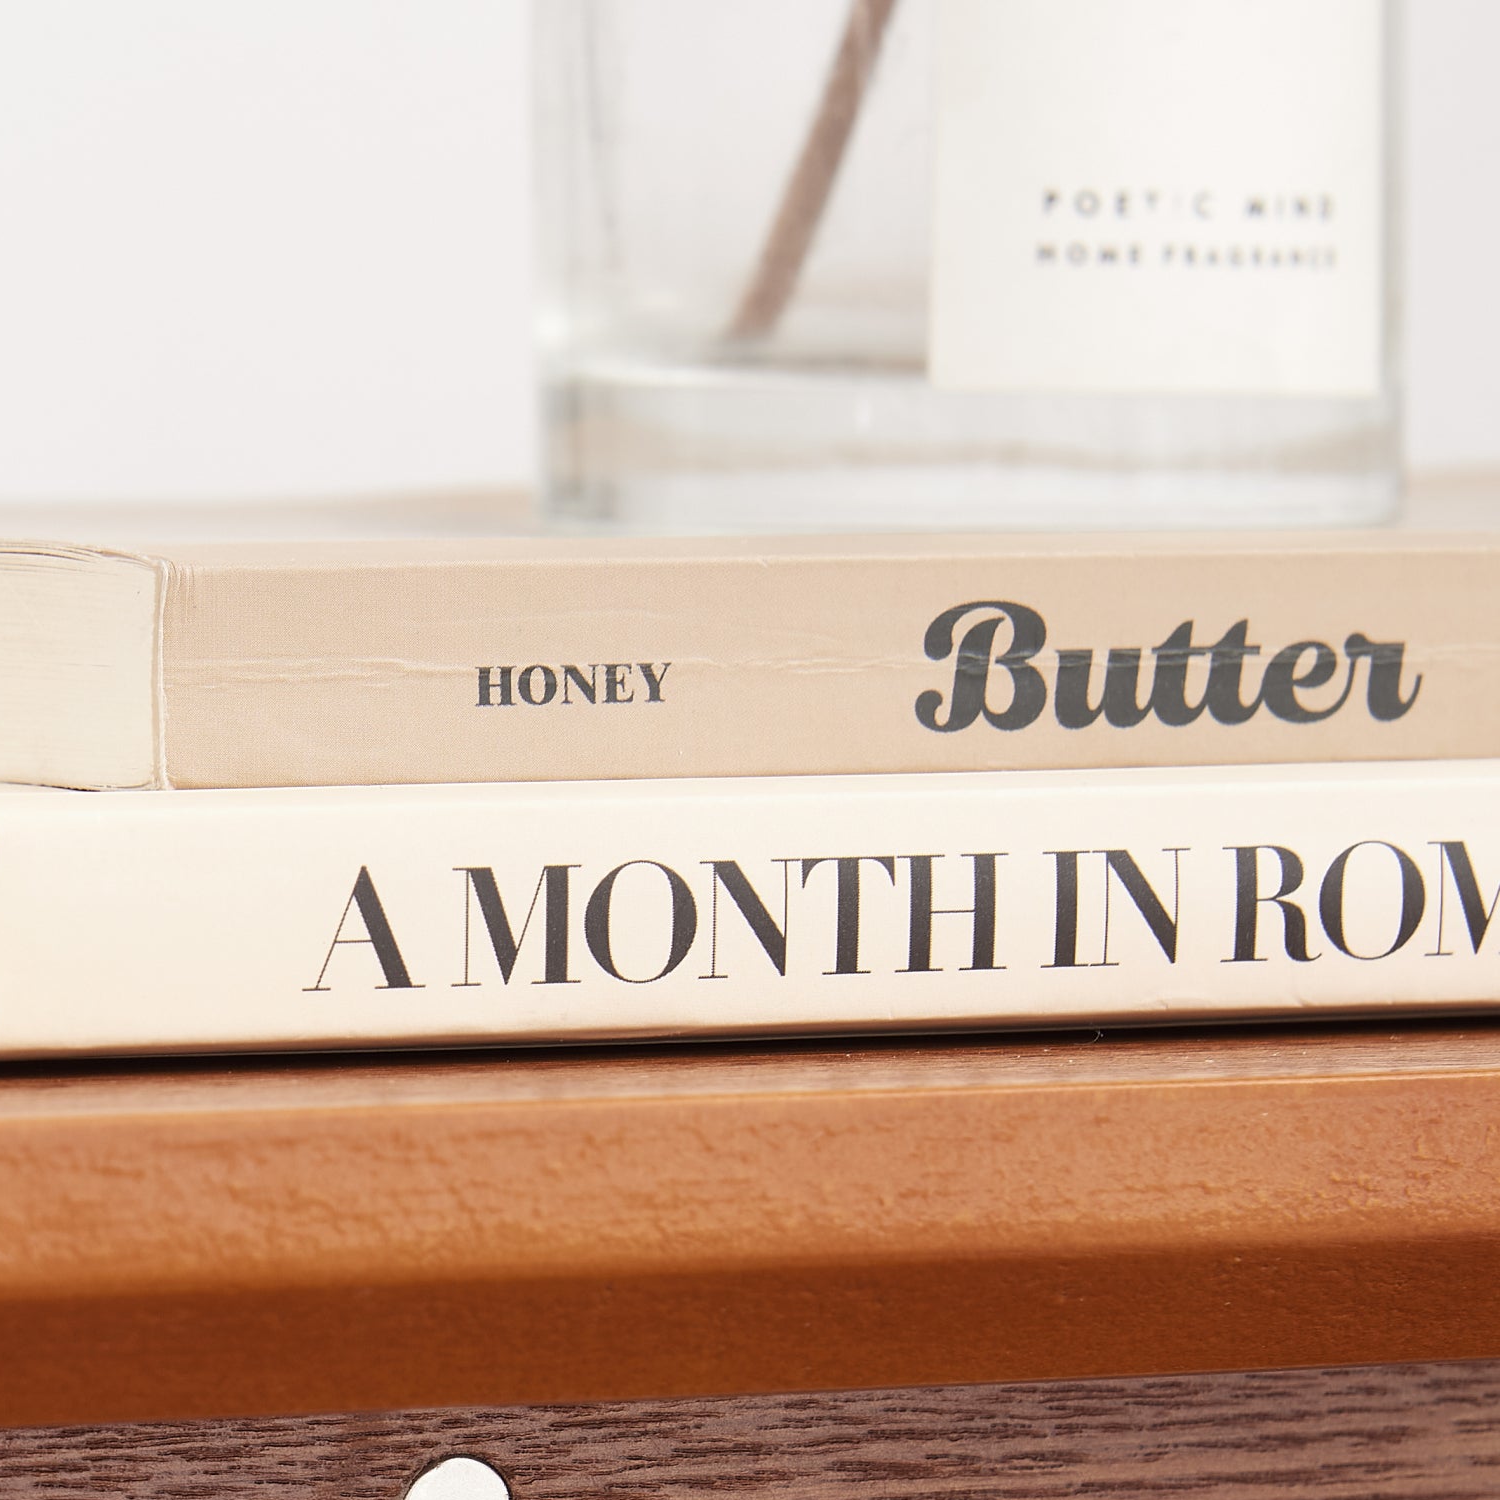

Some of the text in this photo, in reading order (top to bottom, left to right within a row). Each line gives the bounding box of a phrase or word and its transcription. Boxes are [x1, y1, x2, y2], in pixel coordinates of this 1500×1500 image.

[1040, 187, 1212, 219] POETIC
[1033, 242, 1338, 269] HOME FRAGRANCE
[475, 662, 672, 707] HONEY
[914, 600, 1423, 733] Butter
[301, 865, 426, 992] A
[450, 852, 1009, 988] MONTH
[1040, 847, 1191, 969] IN
